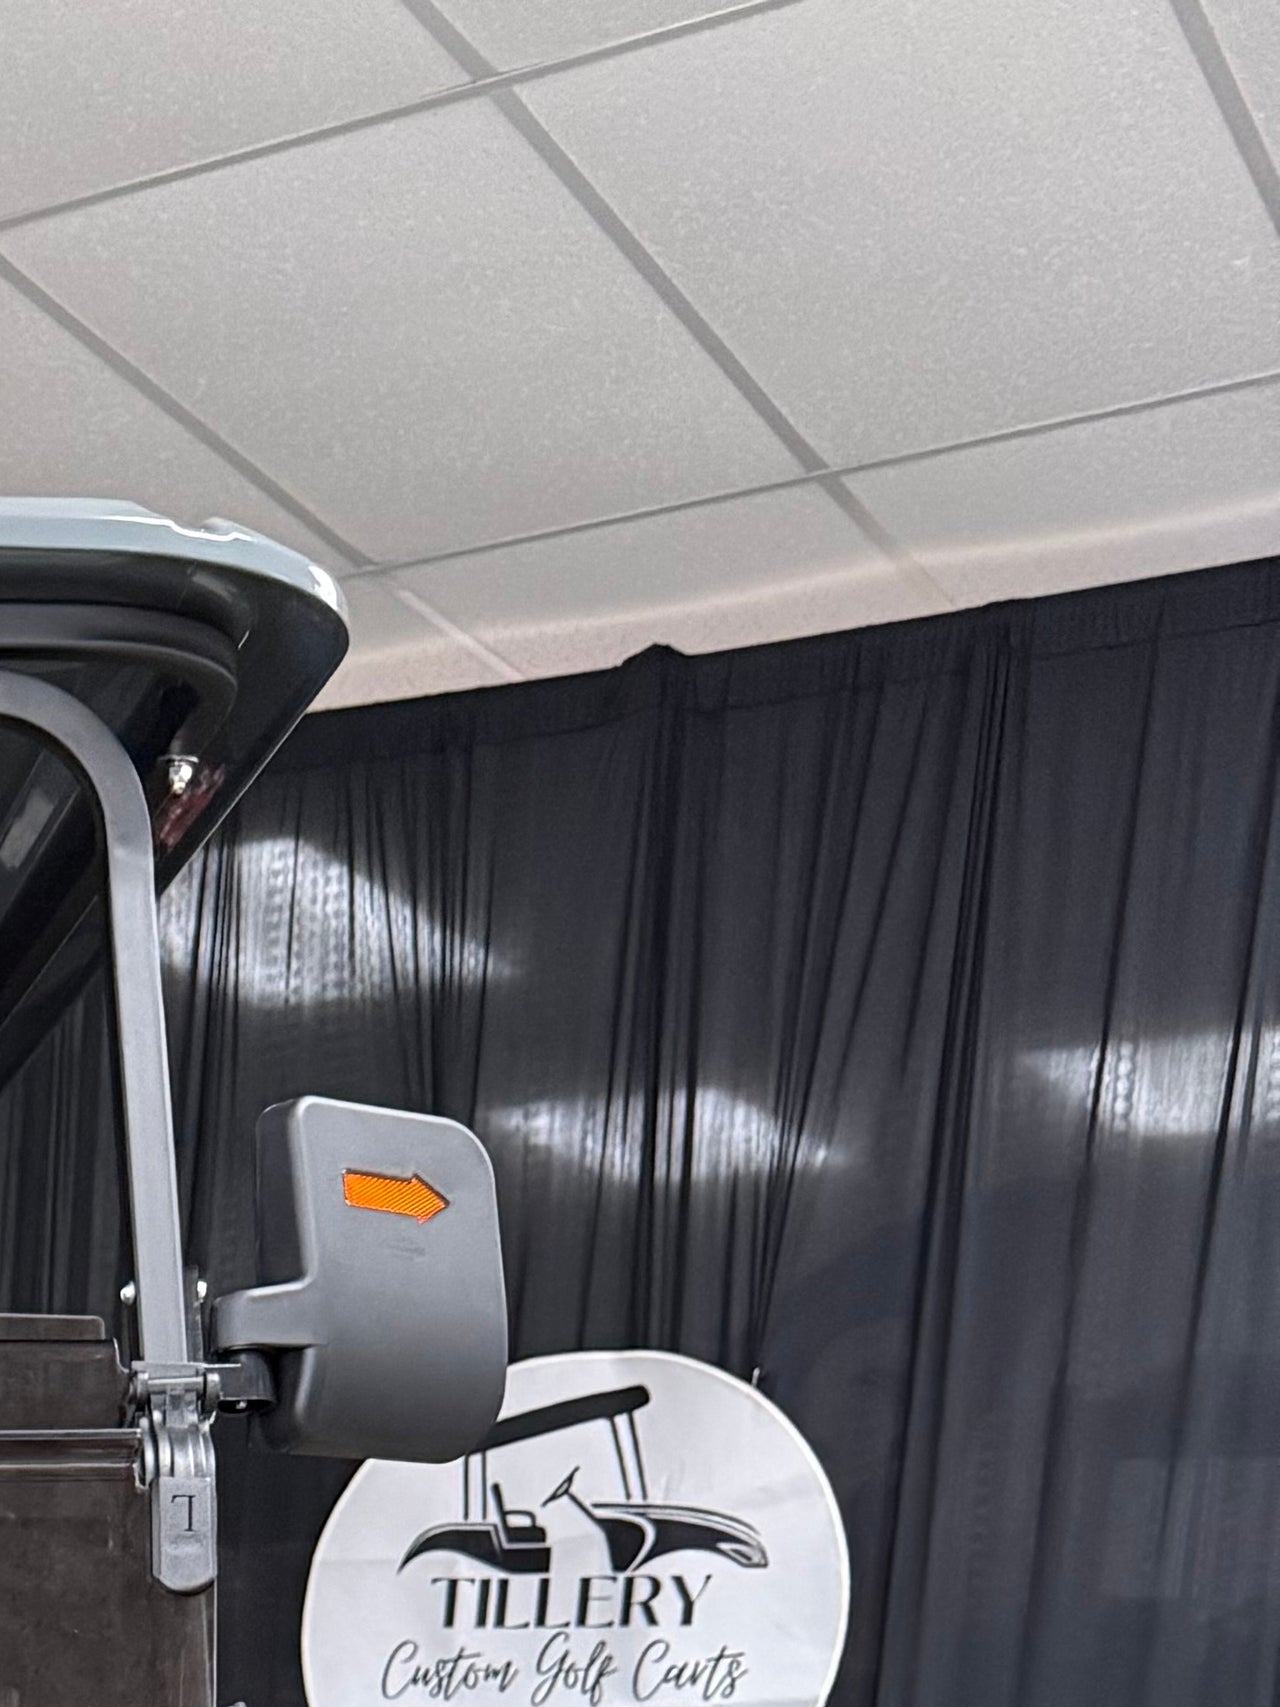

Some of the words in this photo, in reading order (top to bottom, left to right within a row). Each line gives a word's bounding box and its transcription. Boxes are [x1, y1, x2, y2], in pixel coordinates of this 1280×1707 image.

[430, 1573, 712, 1630] TILLERY
[381, 1639, 519, 1701] Custom
[531, 1632, 618, 1707] Golf
[632, 1639, 749, 1702] Carts
